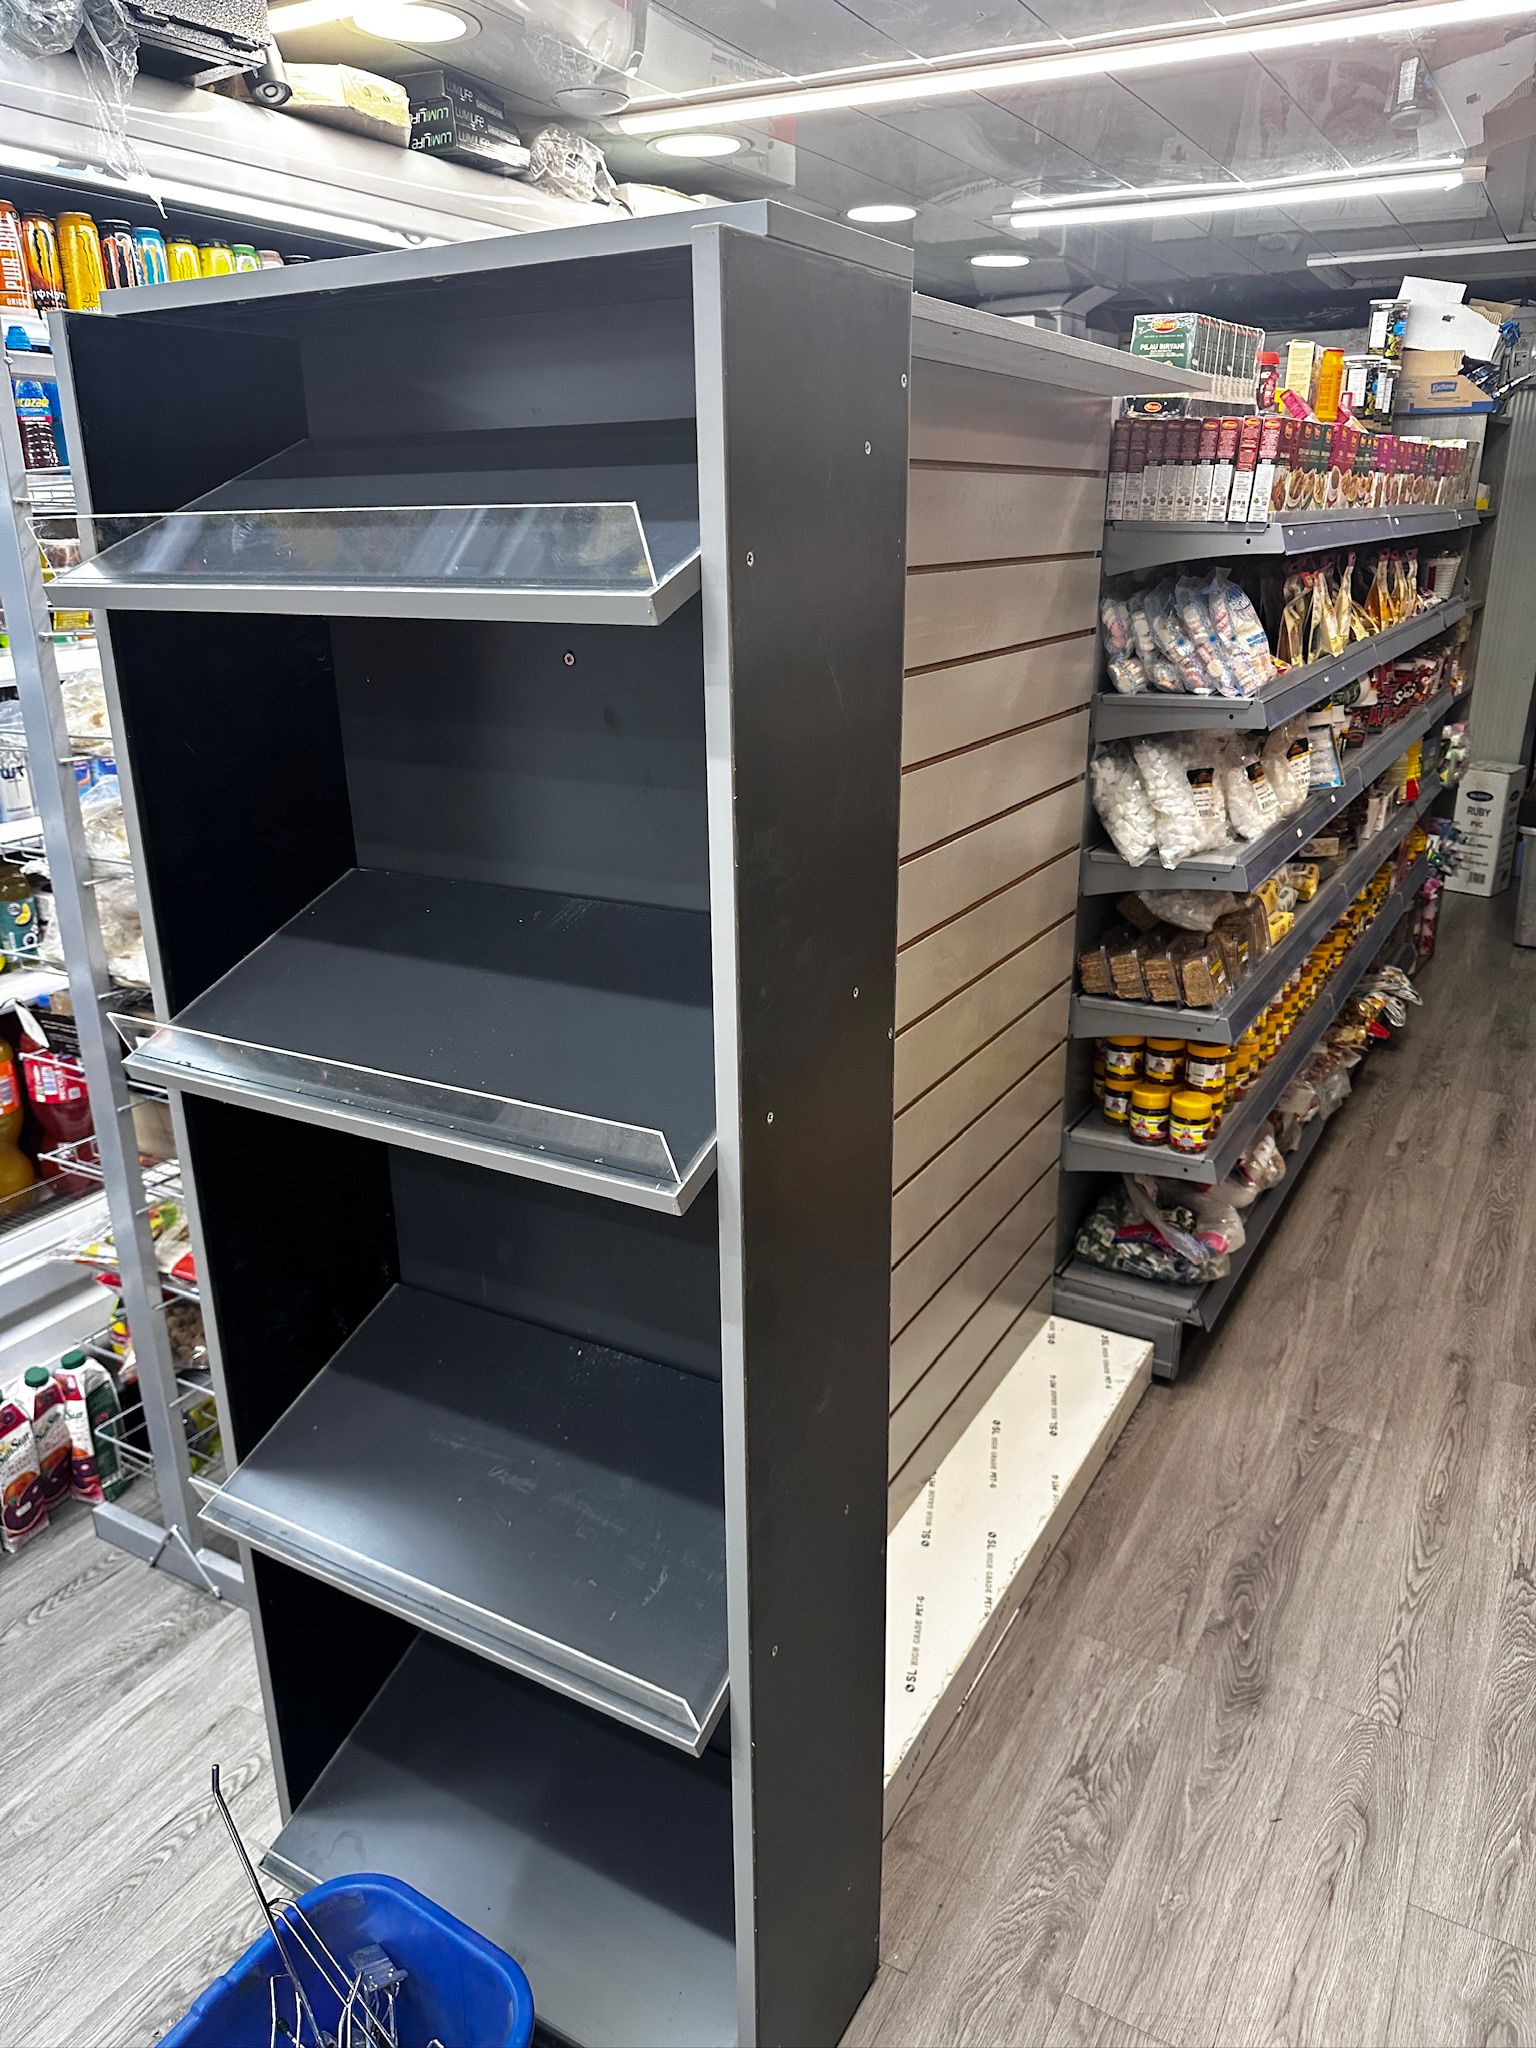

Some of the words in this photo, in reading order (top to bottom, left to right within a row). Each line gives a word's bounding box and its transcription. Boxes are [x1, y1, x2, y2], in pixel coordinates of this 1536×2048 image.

[1, 258, 24, 291] PWR
[1151, 320, 1176, 331] Shan
[1139, 343, 1159, 351] PILAU
[1159, 342, 1186, 350] BIRYANI
[1467, 806, 1491, 817] RUBY
[912, 1619, 923, 1644] GRADE
[910, 1646, 920, 1666] HIGH
